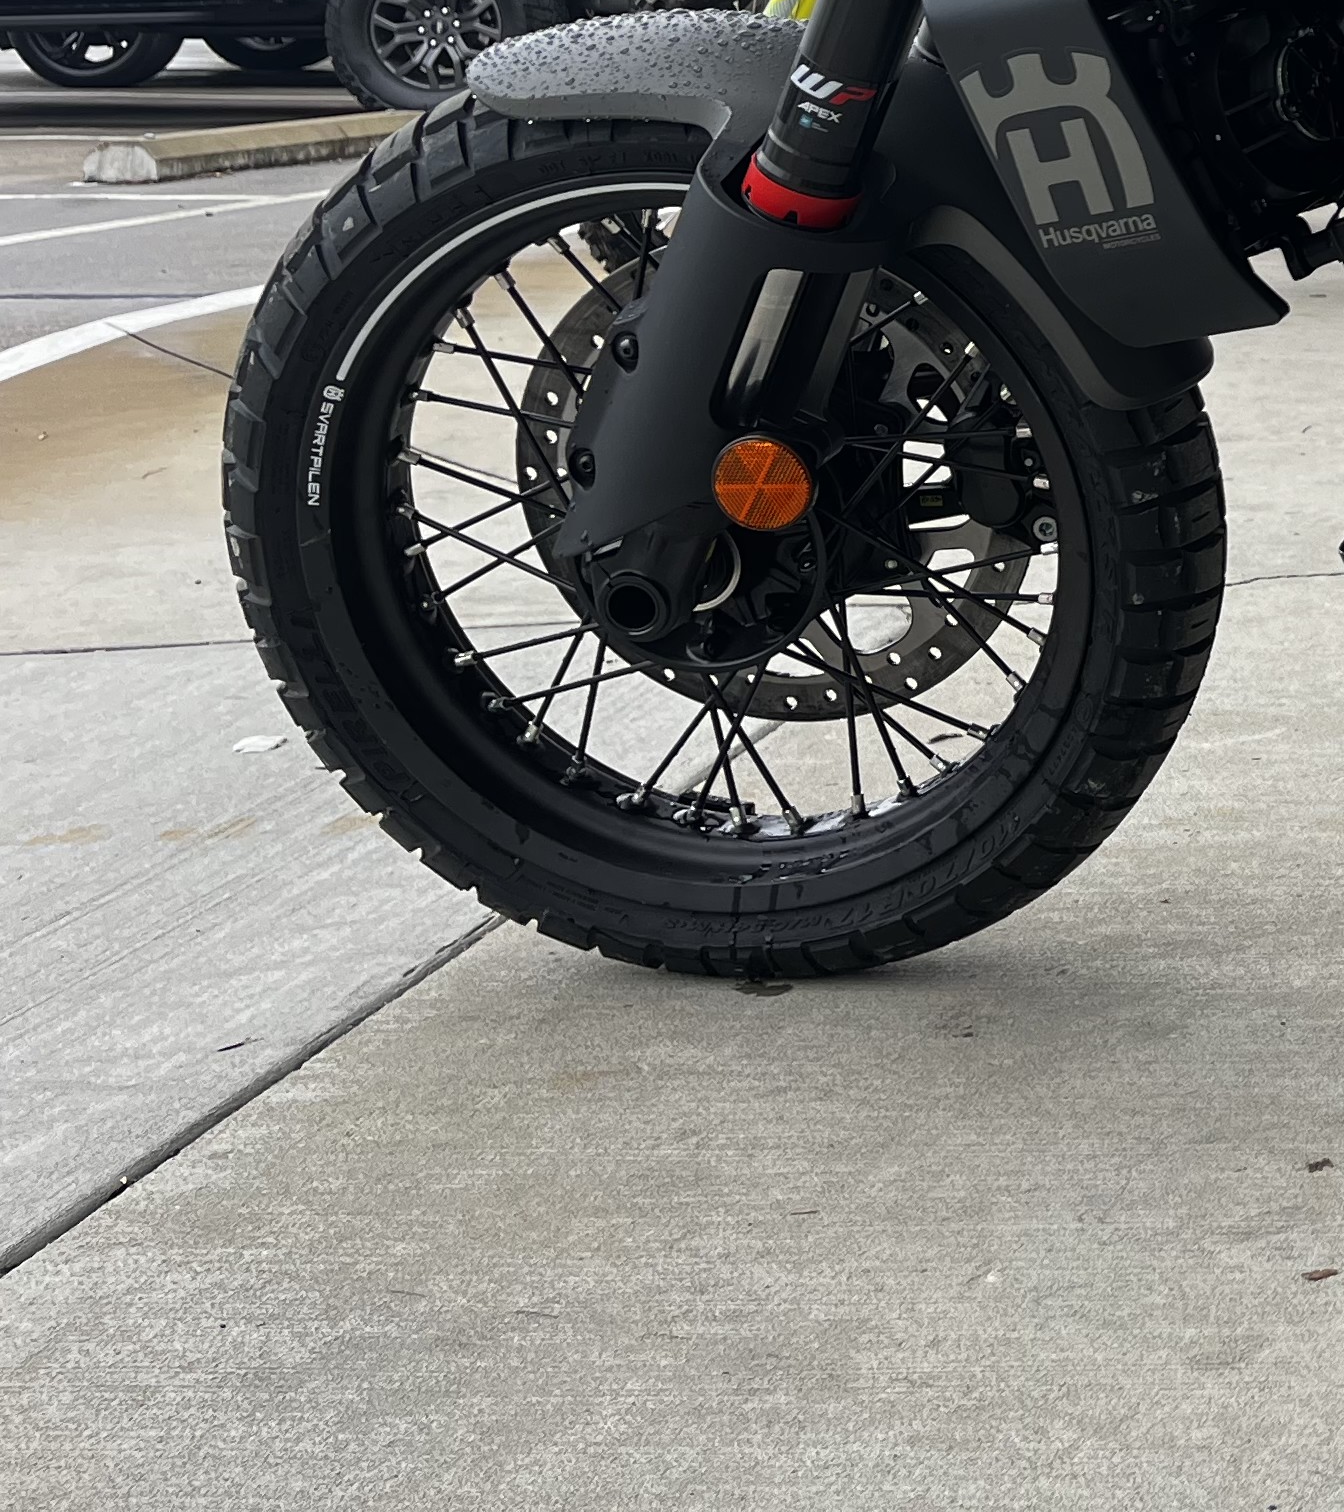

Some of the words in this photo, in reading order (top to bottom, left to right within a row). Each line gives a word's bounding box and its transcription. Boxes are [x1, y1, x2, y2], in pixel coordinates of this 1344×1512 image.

[790, 63, 878, 106] WP
[797, 101, 842, 124] APEX
[1038, 213, 1157, 249] Husqvarna
[307, 401, 335, 506] SVARTPILEN
